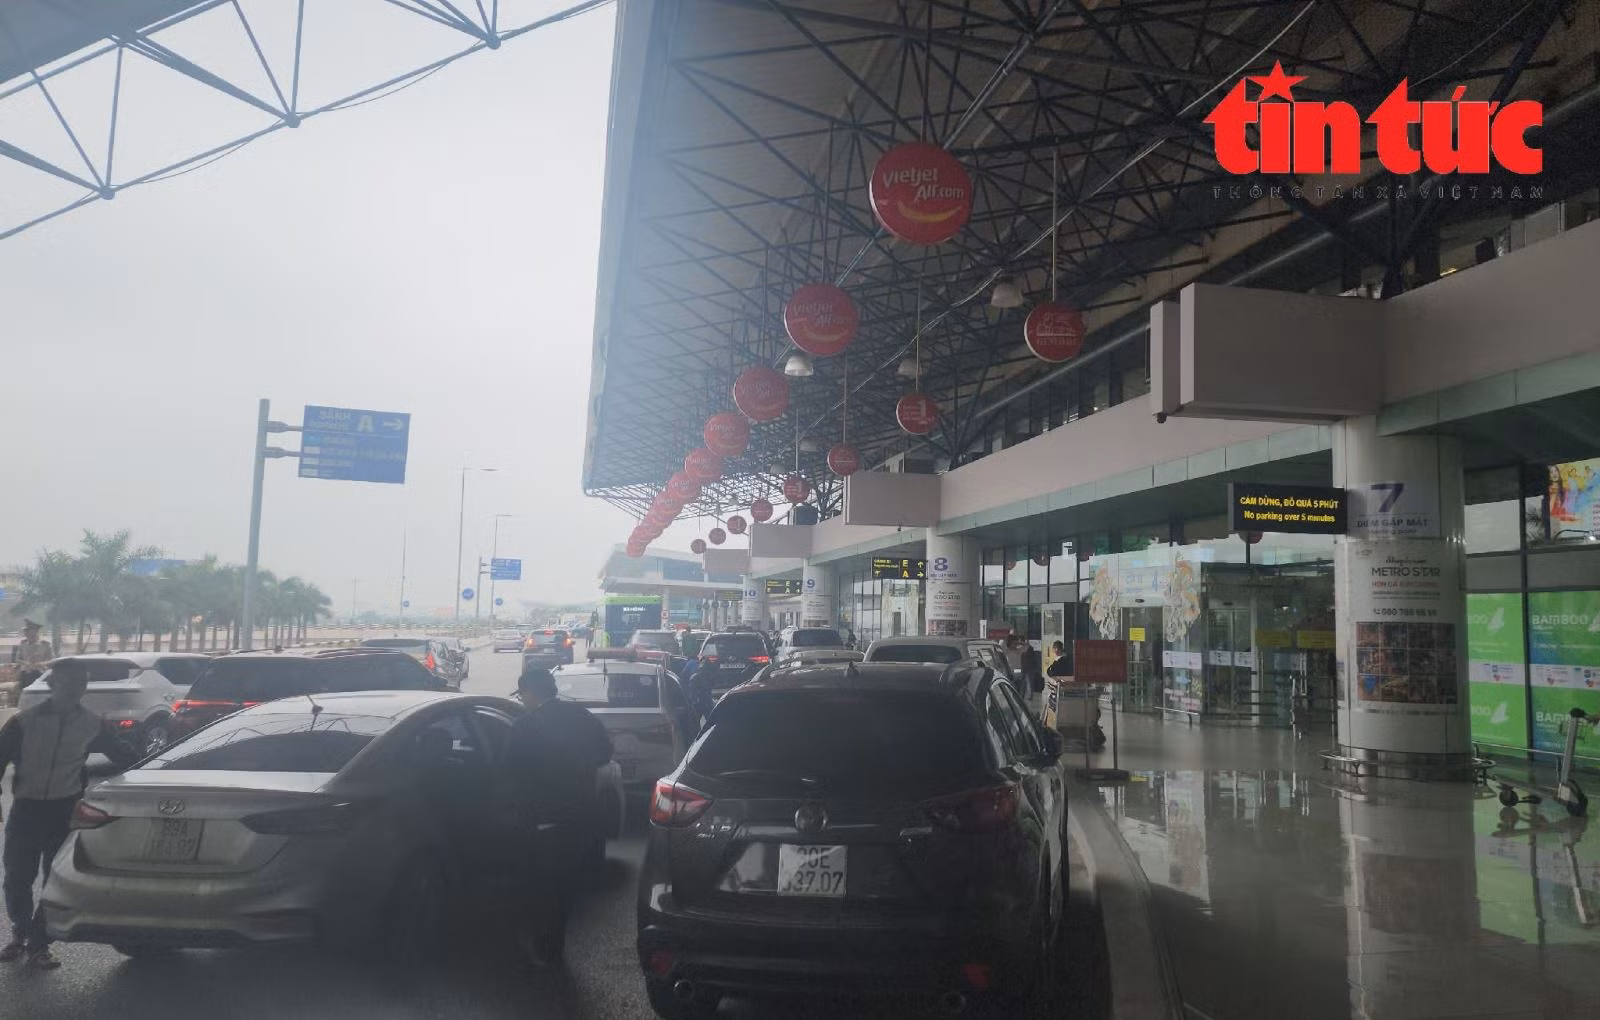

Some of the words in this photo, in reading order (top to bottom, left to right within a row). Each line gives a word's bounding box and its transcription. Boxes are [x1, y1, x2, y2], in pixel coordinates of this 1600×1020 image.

[356, 415, 374, 432] A
[1371, 482, 1405, 513] 7
[1313, 500, 1319, 508] 5
[1244, 510, 1254, 519] No
[1256, 511, 1282, 522] parking
[1284, 513, 1300, 521] over
[1307, 514, 1335, 522] minutes
[902, 559, 909, 567] E
[933, 557, 948, 571] 8
[902, 570, 910, 578] A
[1371, 566, 1410, 577] METRO
[1412, 566, 1441, 577] STAR
[806, 578, 815, 588] 9
[1532, 614, 1589, 626] BAMBOO
